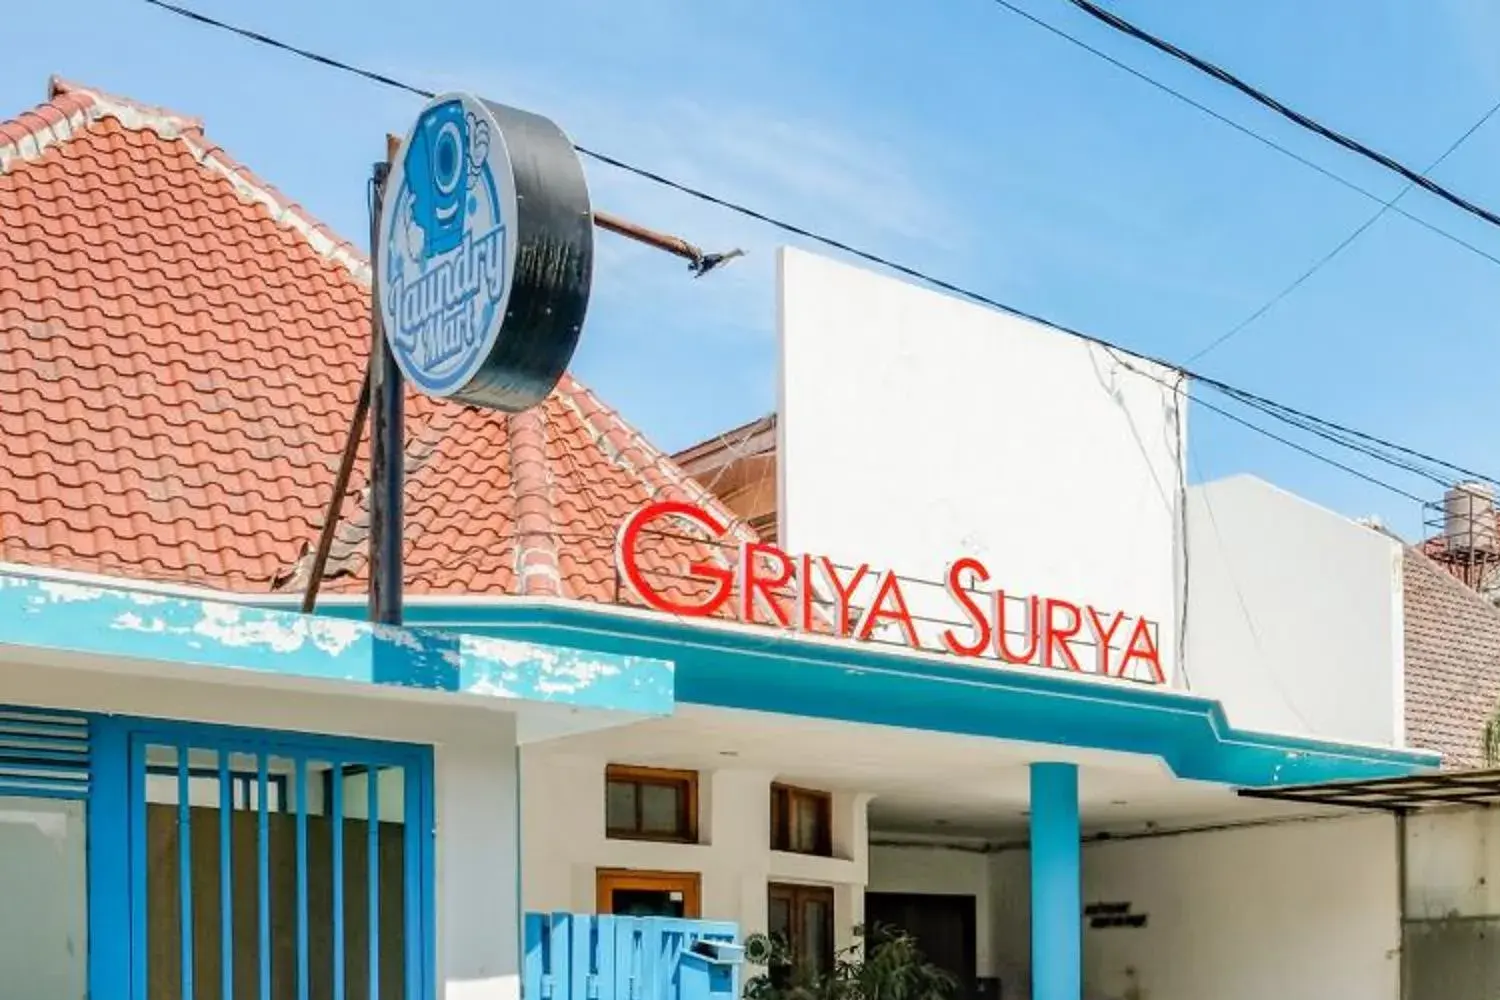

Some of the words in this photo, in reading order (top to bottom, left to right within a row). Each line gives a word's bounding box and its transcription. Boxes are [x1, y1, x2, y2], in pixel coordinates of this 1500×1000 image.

[388, 224, 506, 353] Laundry
[616, 501, 923, 648] GRIYA
[944, 557, 1166, 685] SURYA
